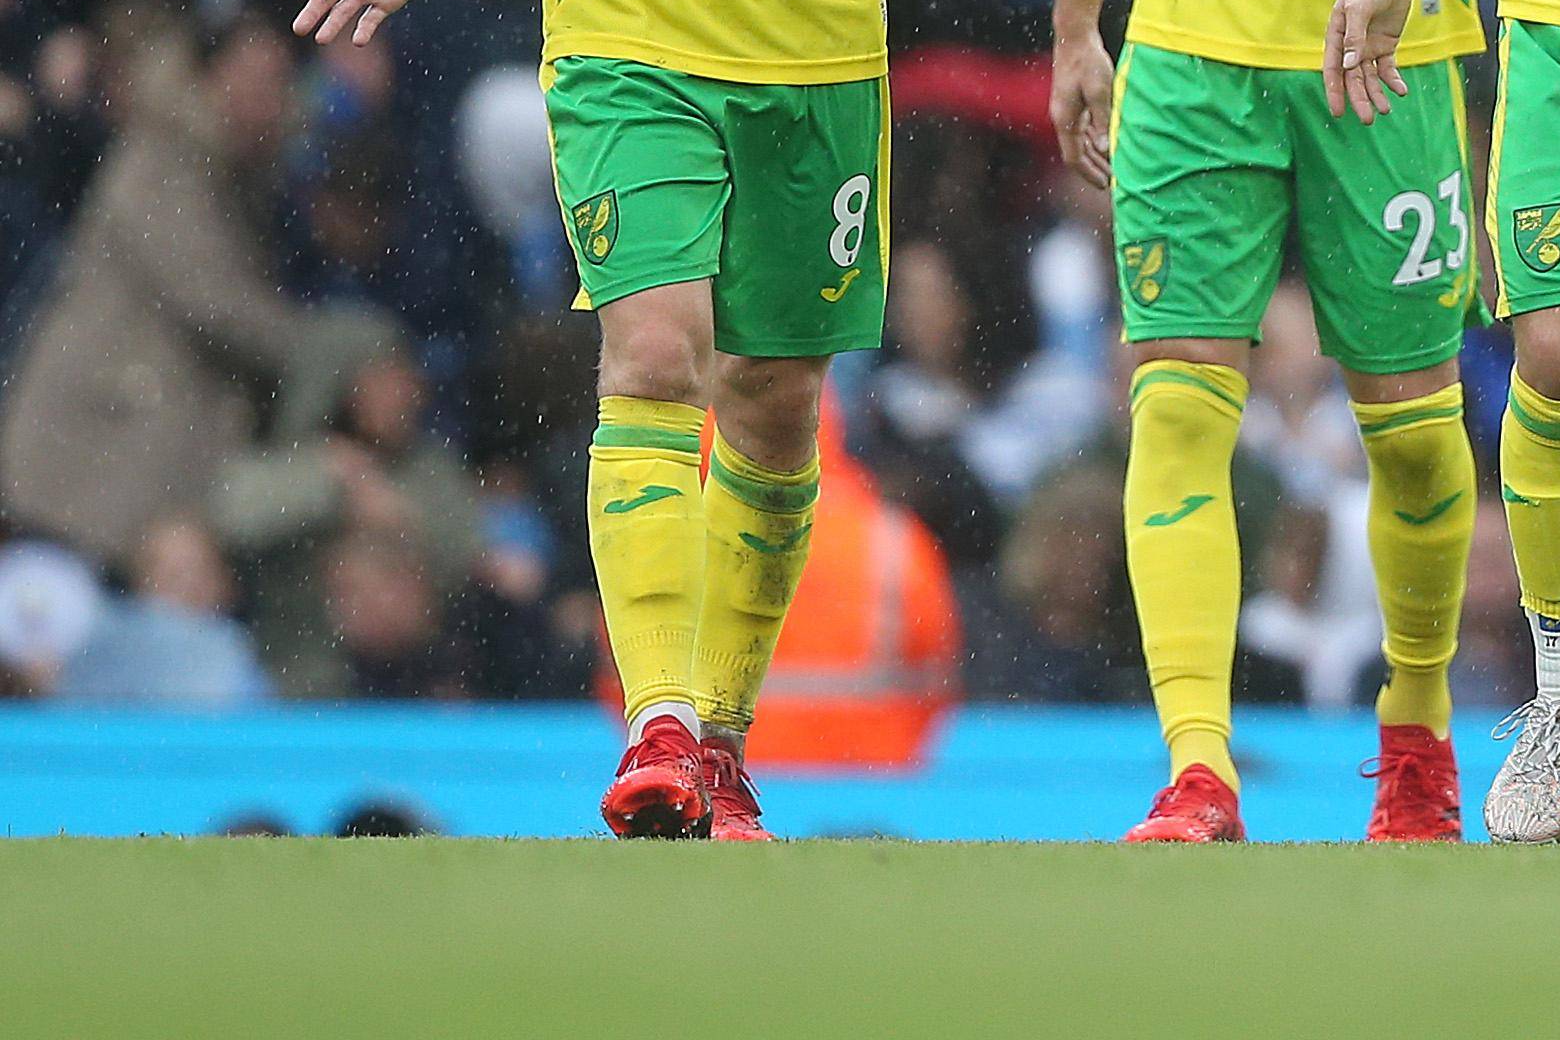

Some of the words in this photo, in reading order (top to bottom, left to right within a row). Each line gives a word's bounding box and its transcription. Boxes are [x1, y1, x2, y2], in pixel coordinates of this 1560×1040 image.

[829, 173, 871, 267] 8
[1383, 170, 1469, 286] 23
[1545, 635, 1560, 647] 17
